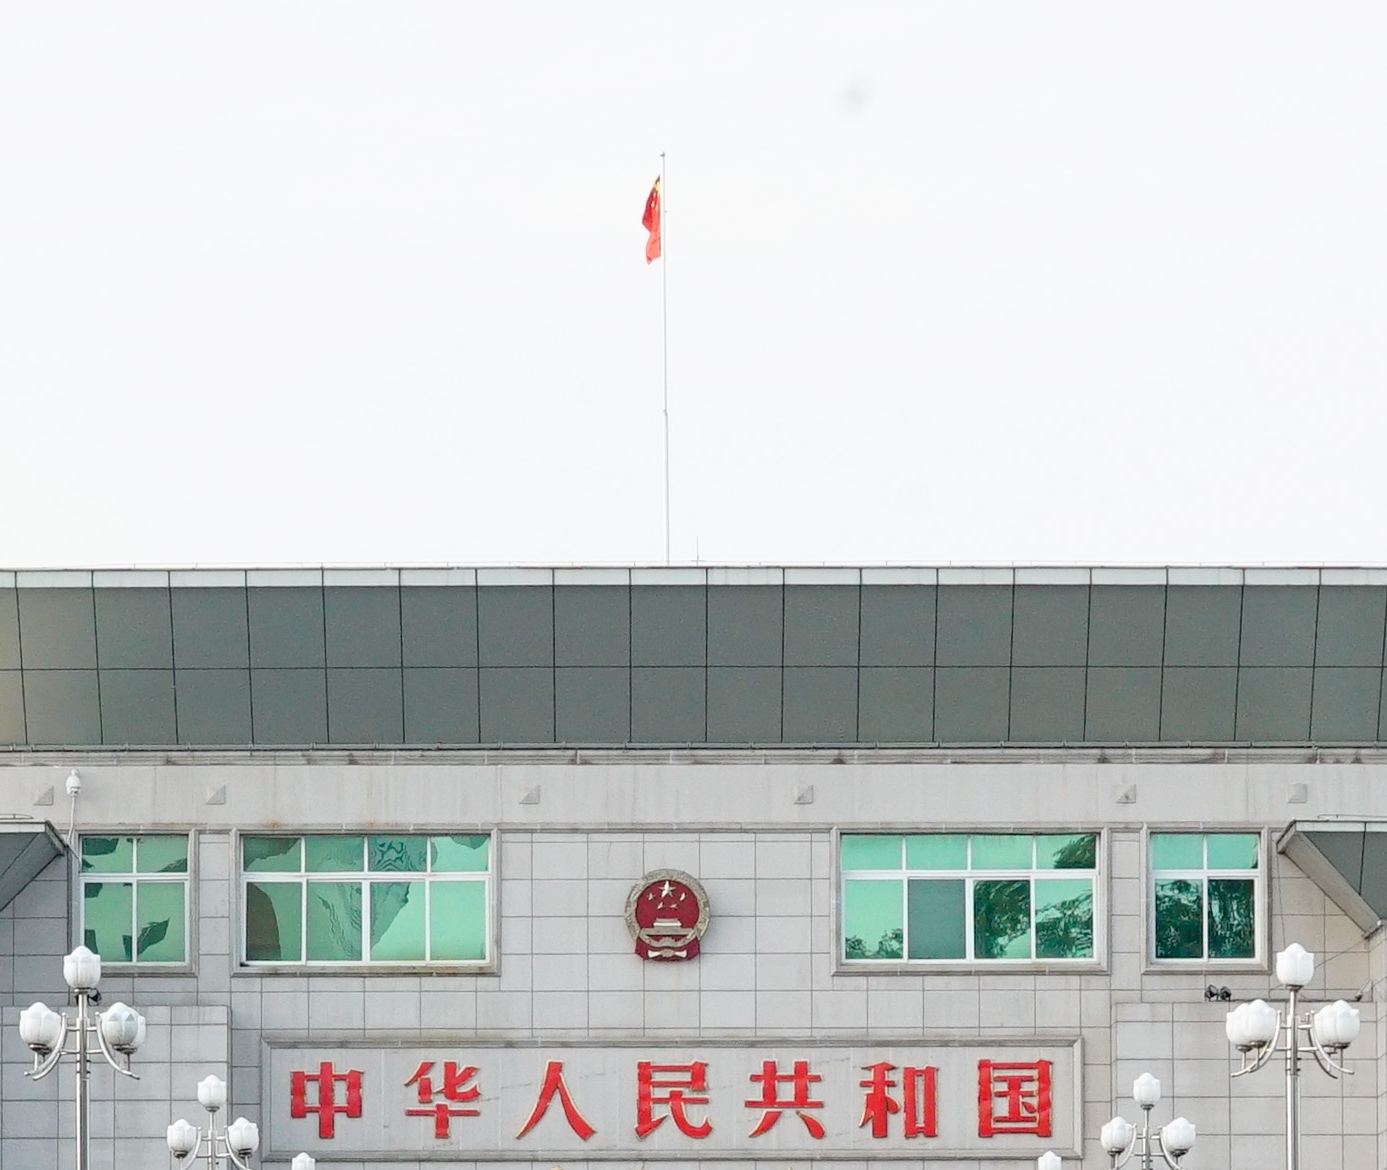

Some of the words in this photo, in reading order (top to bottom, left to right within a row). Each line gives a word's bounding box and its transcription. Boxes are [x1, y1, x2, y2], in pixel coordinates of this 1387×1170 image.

[290, 1058, 1053, 1140] 中华人民共和国
